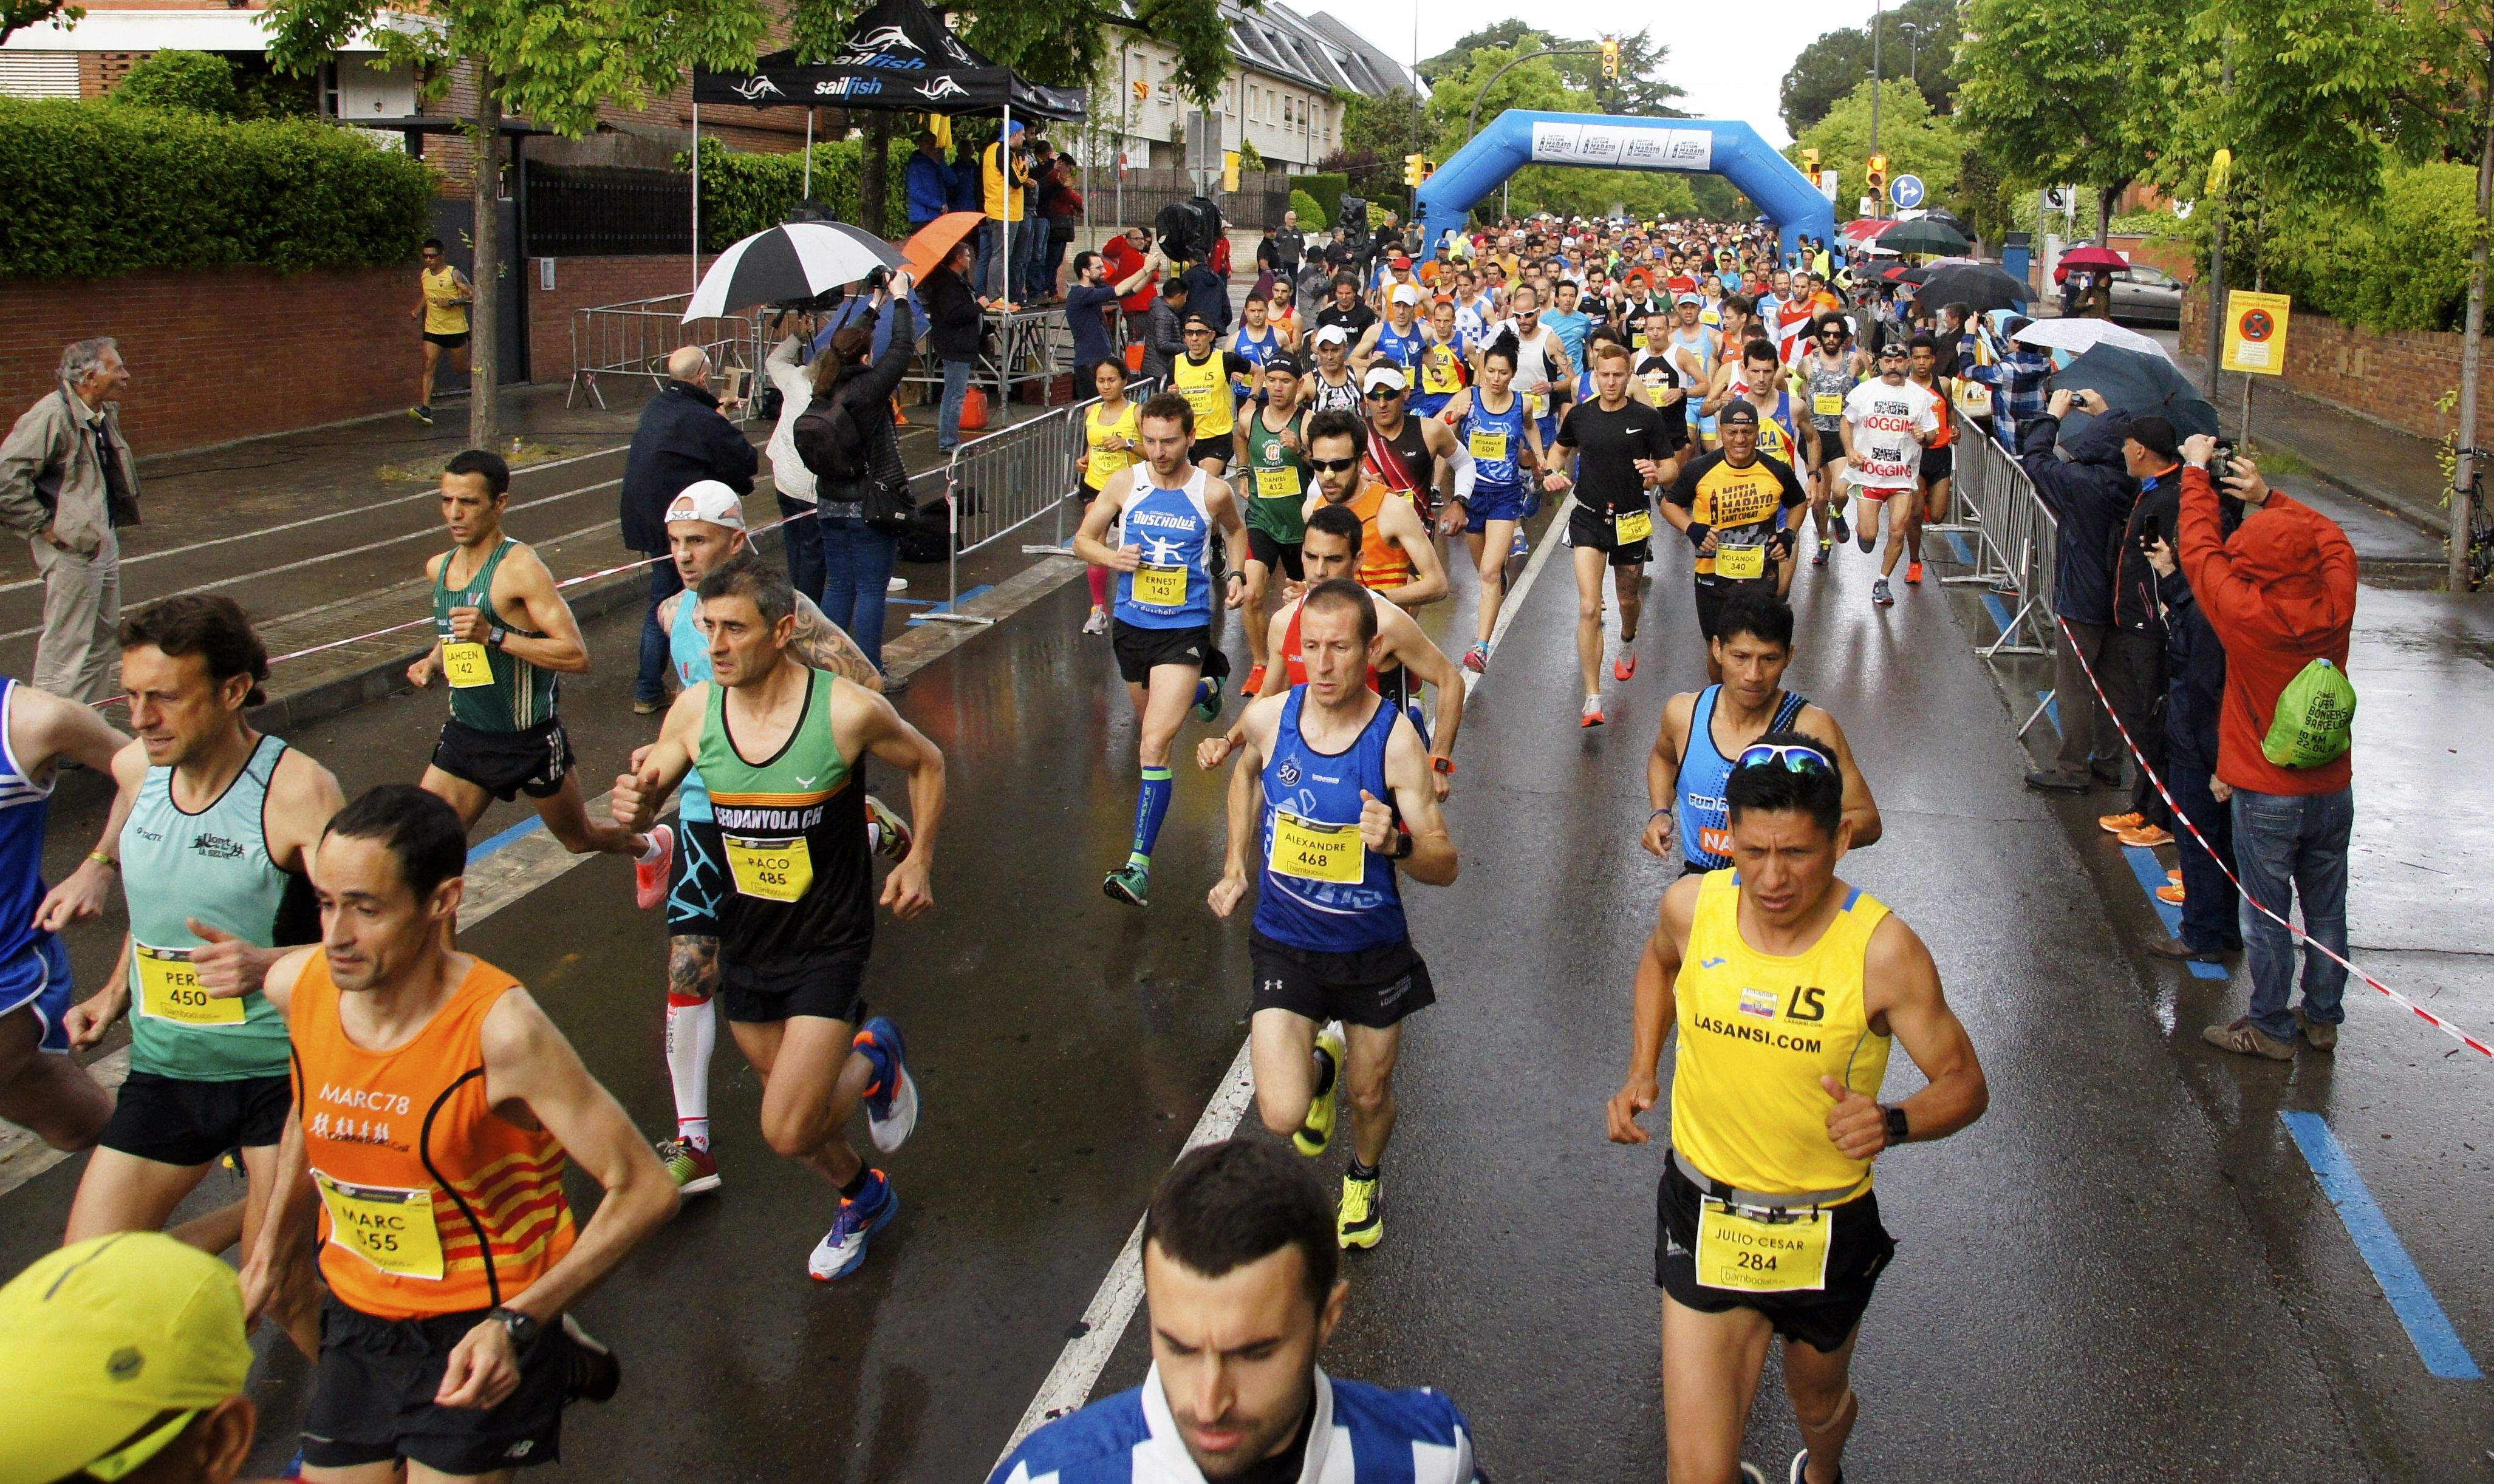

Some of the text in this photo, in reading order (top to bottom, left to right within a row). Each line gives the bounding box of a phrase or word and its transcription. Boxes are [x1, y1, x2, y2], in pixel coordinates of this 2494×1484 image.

[814, 77, 882, 100] sailfish
[1204, 371, 1214, 381] LS
[1864, 416, 1913, 432] JOGGIN
[1859, 460, 1912, 479] JOGGING
[1721, 511, 1758, 523] SANT CUGAT
[1730, 562, 1746, 571] 340
[1146, 576, 1177, 586] ERNEST
[1151, 585, 1170, 596] 143
[447, 651, 479, 661] LAHCEN
[456, 662, 473, 674] 142
[2299, 729, 2327, 745] 10 KM
[1278, 765, 1297, 781] 30
[715, 805, 824, 830] CERDANYOLA CH
[1285, 832, 1347, 852] ALEXANDRE
[748, 857, 790, 870] PACO
[1297, 851, 1328, 867] 468
[759, 871, 787, 885] 485
[166, 972, 199, 986] PER
[170, 989, 207, 1006] 450
[1746, 989, 1774, 998] ECUADOR
[1786, 985, 1826, 1021] LS
[1693, 1012, 1822, 1053] LASANSI.COM
[319, 1081, 410, 1115] MARC78
[341, 1207, 406, 1230] MARC
[1715, 1228, 1805, 1251] JULIO CESAR
[1737, 1251, 1777, 1271] 284
